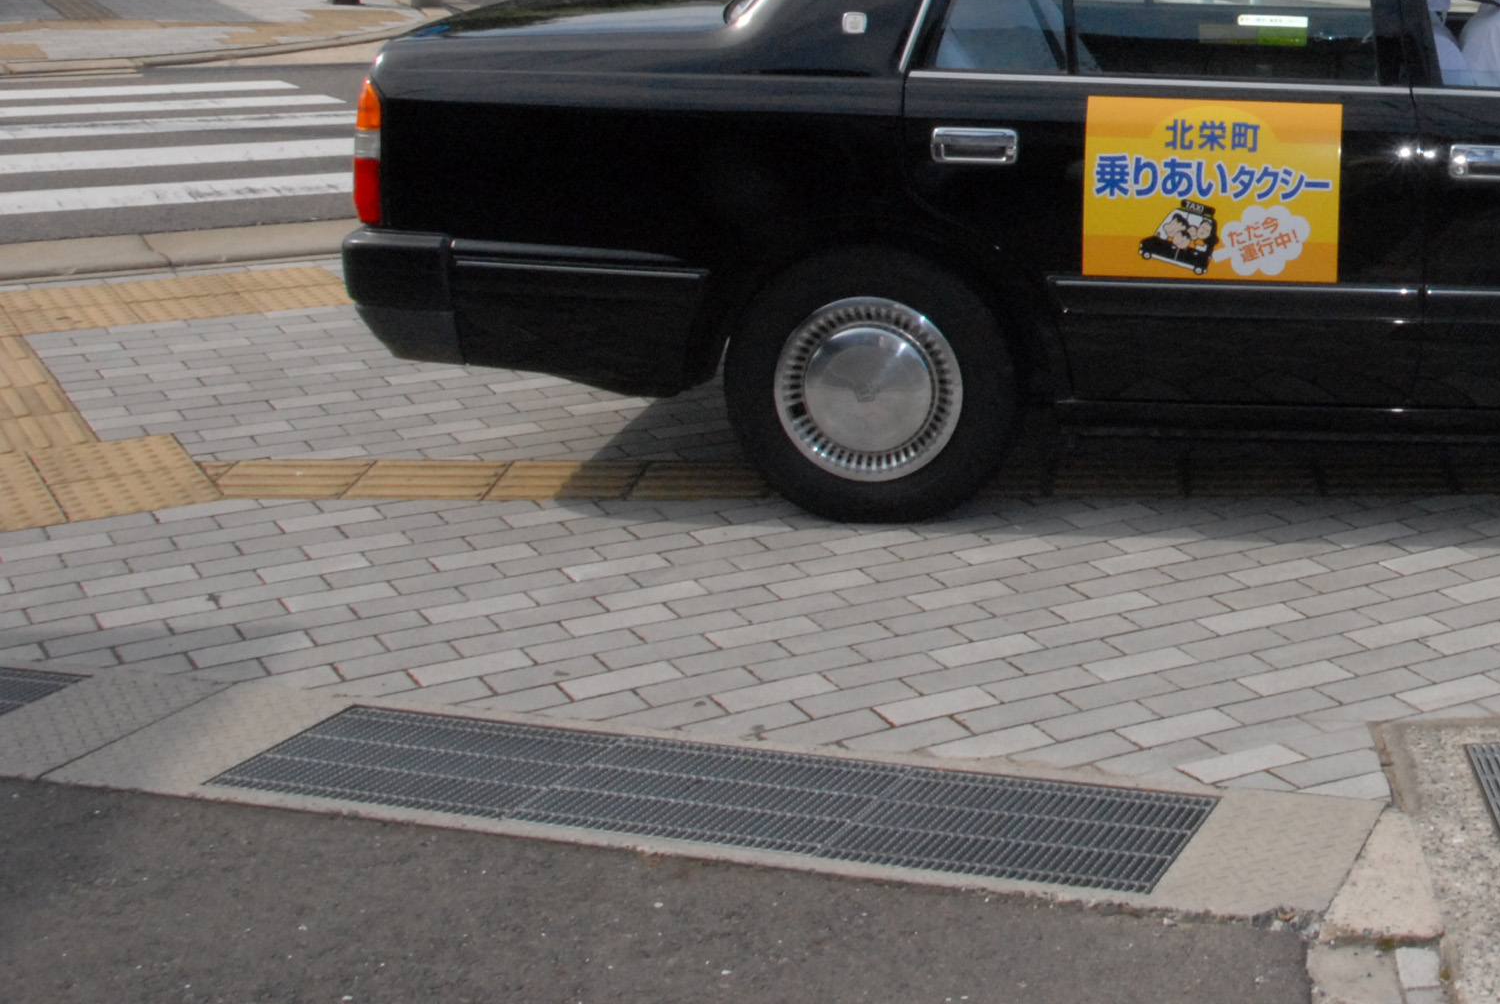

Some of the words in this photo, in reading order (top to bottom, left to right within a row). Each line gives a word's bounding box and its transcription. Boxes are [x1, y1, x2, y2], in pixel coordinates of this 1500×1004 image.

[1165, 119, 1261, 153] 北栄町
[1094, 154, 1331, 202] 乗りあいタクシー
[1227, 216, 1279, 247] ただ今
